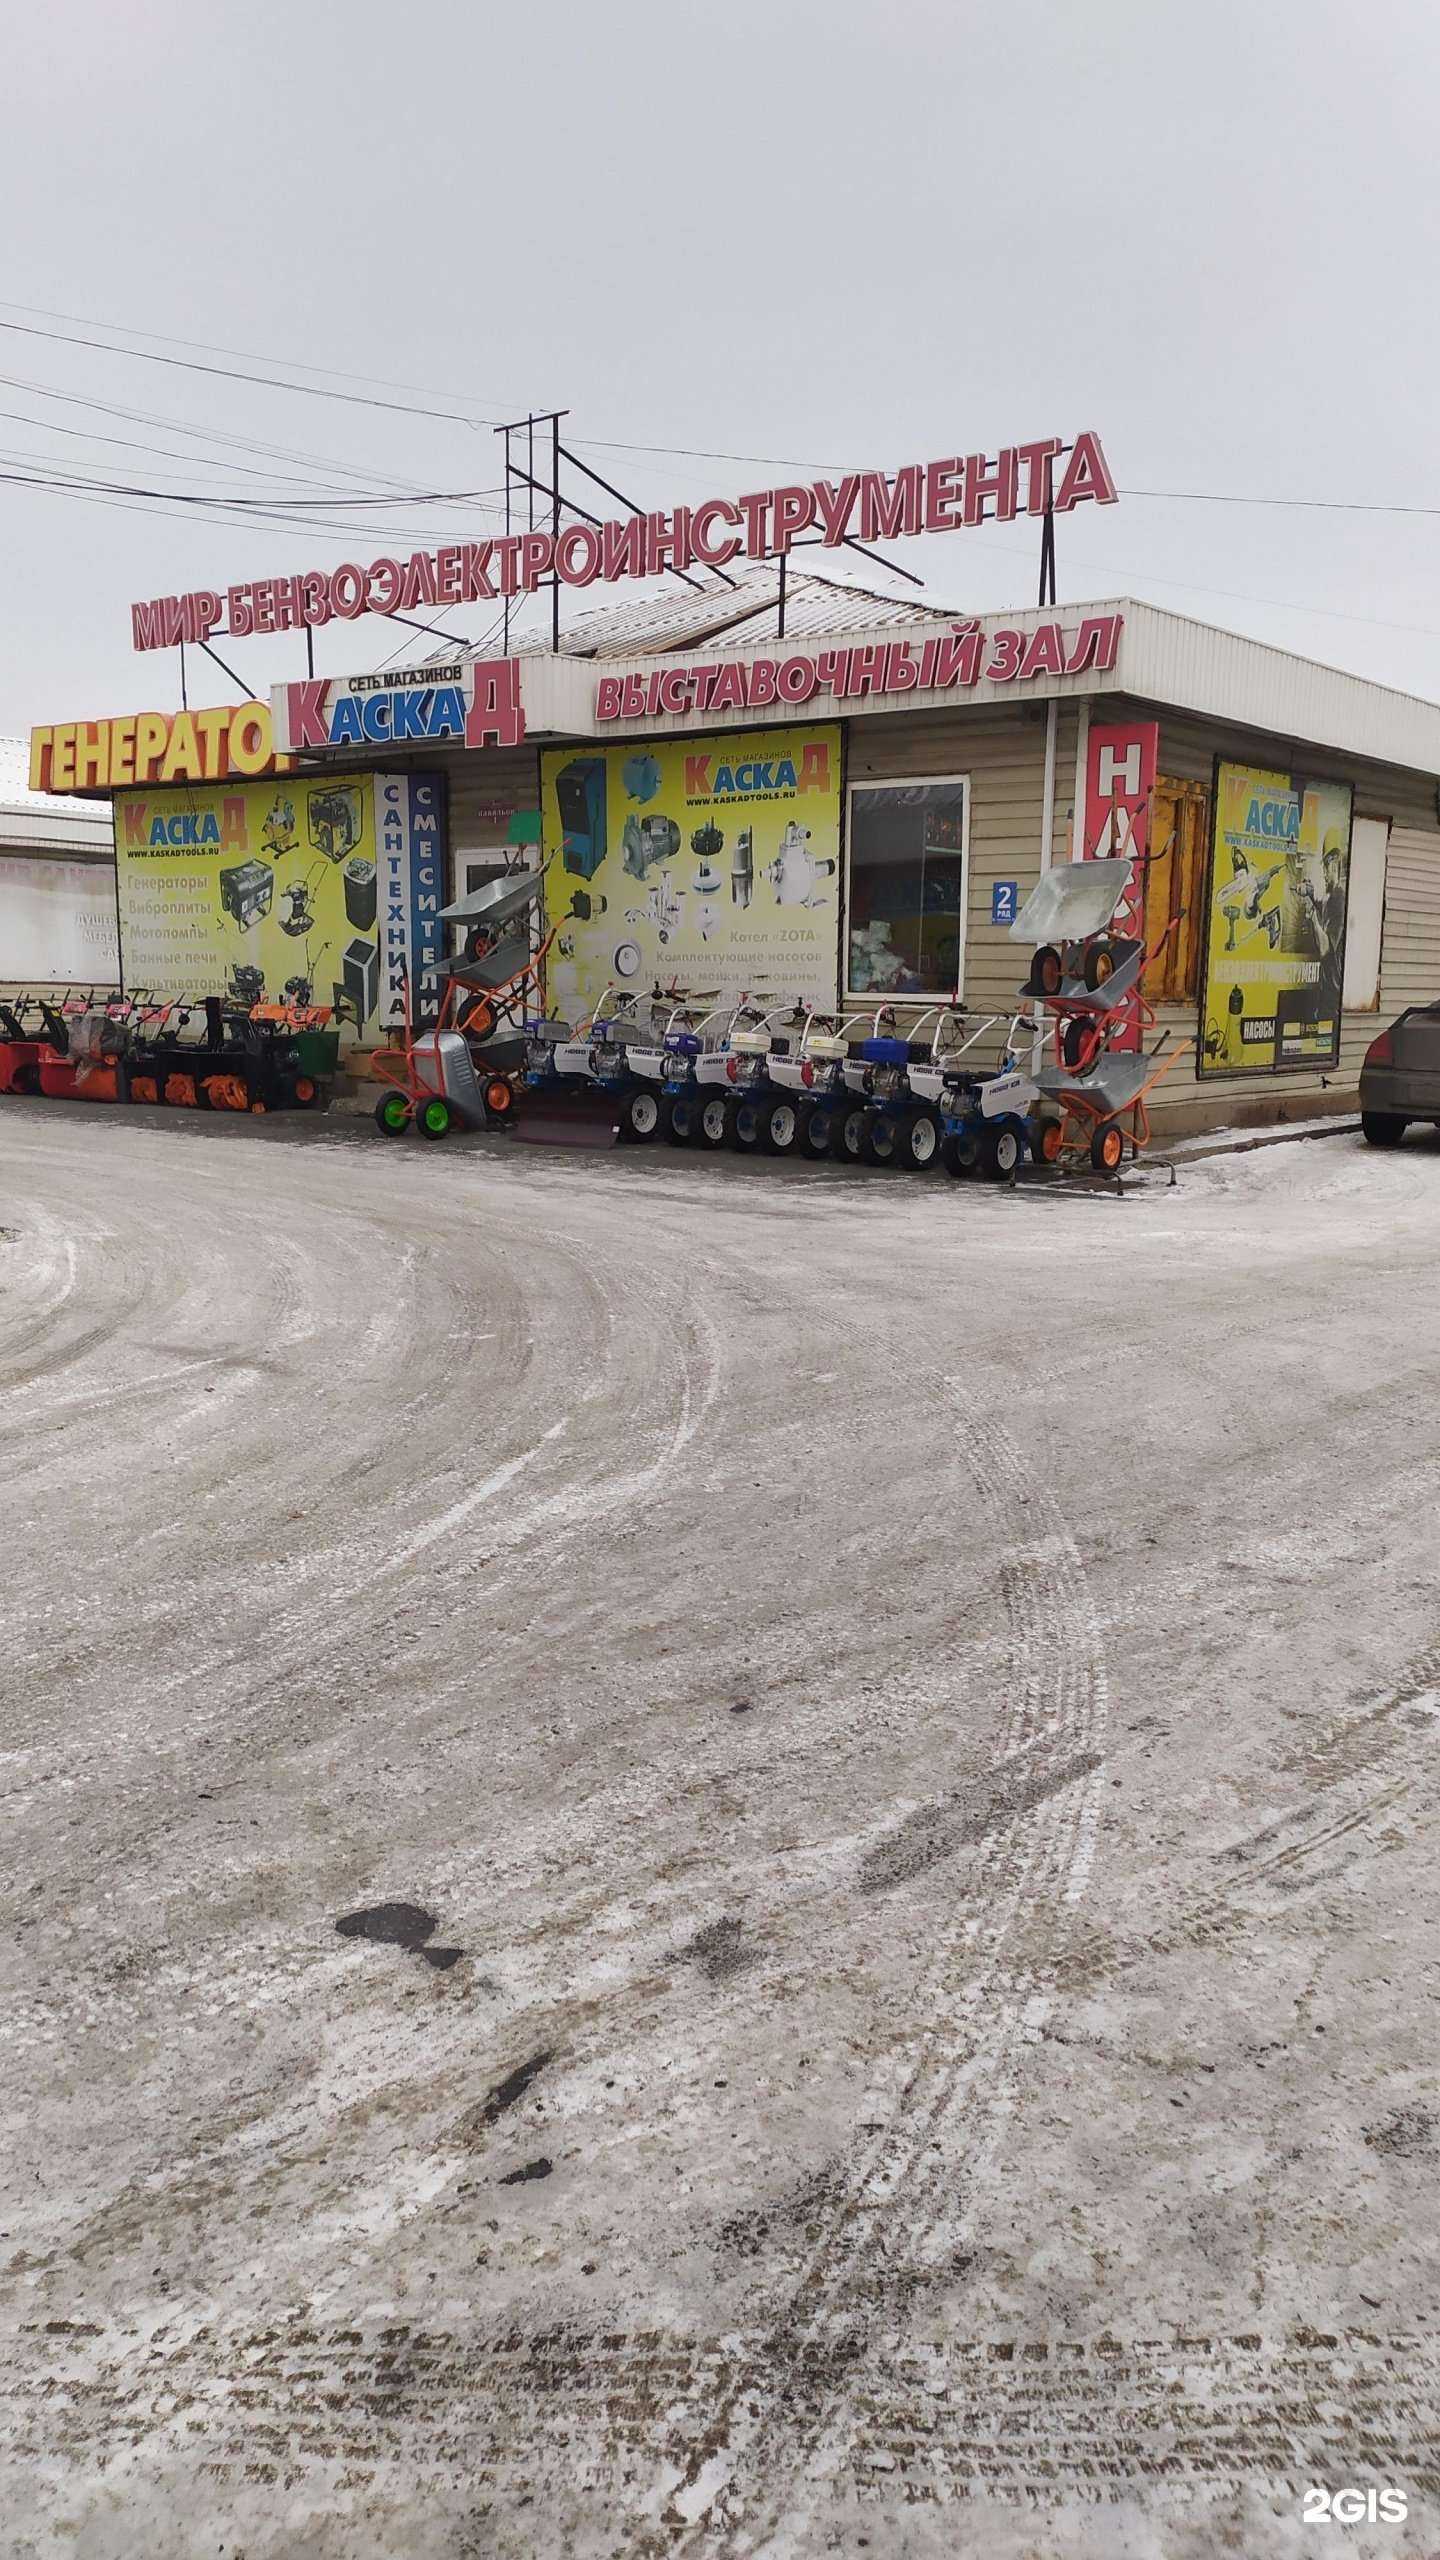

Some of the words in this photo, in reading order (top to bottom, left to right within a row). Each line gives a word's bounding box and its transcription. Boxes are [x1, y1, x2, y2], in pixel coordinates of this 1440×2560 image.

[131, 591, 223, 651] МИР
[228, 431, 1119, 637] БЕНЗОЭЛЕКТРОИНСТРУМЕНТА
[349, 676, 381, 692] СЕТЬ
[384, 665, 462, 688] МАГАЗИНОВ
[596, 620, 984, 720] ВЫСТАВОЧНЫЙ
[985, 614, 1124, 682] ЗАЛ
[288, 658, 526, 749] КАСКАД
[29, 701, 290, 790] ГЕНЕРАТО
[720, 753, 739, 764] СЕТЬ
[743, 750, 792, 762] МАГАЗИНОВ
[685, 743, 830, 795] КАСКАД
[686, 791, 796, 807] WWW.KASKADTOOLS.RU
[124, 797, 248, 851] КАСКАД
[127, 847, 220, 859] WWW.KASKADTOOLS.RU
[127, 875, 208, 894] Генераторы
[384, 784, 406, 1016] САНТЕХНИКА
[413, 786, 440, 1017] СМЕСИТЕЛИ
[998, 886, 1011, 909] 2
[129, 900, 211, 919] Виброплиты
[730, 931, 768, 943] Котел
[131, 949, 181, 964] Банные
[185, 951, 217, 965] печи
[769, 952, 822, 962] насосов
[1244, 1020, 1276, 1040] НАСОСЫ
